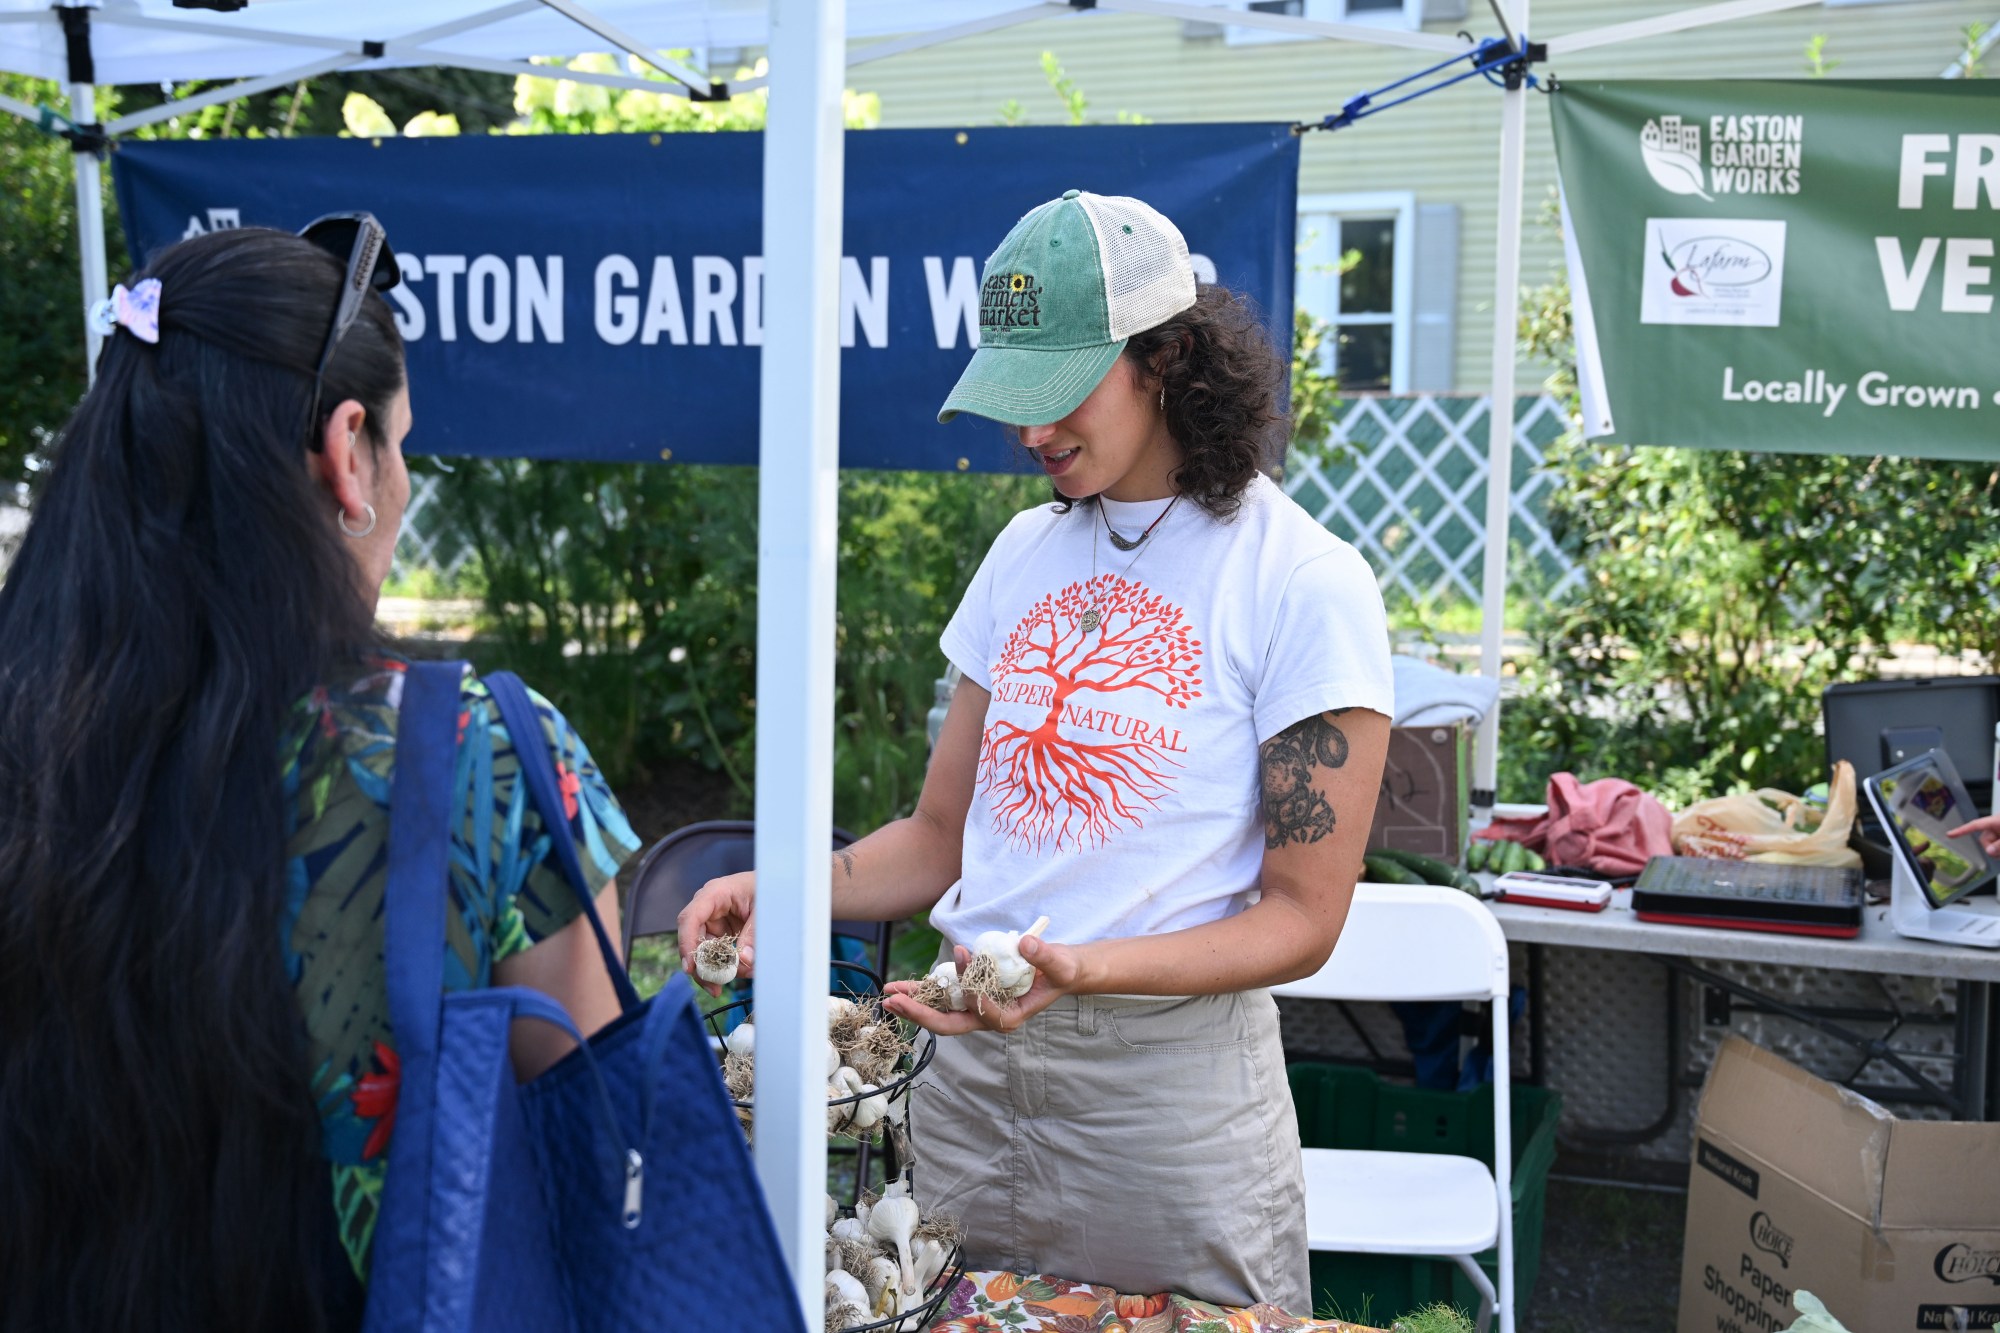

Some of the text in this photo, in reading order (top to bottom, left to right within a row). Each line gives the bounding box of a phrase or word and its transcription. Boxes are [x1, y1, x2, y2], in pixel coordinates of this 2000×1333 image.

[1710, 115, 1803, 141] EASTON
[1711, 142, 1801, 168] GARDEN
[1711, 167, 1800, 194] WORKS
[1874, 236, 1995, 313] VE
[390, 253, 564, 343] STON
[594, 254, 889, 348] GARN
[980, 306, 1041, 326] market
[1722, 366, 1980, 417] Locally Grown
[994, 682, 1188, 753] SUPER NATURAL
[1740, 1253, 1791, 1307] Paper
[1934, 1243, 2000, 1286] CHOIC
